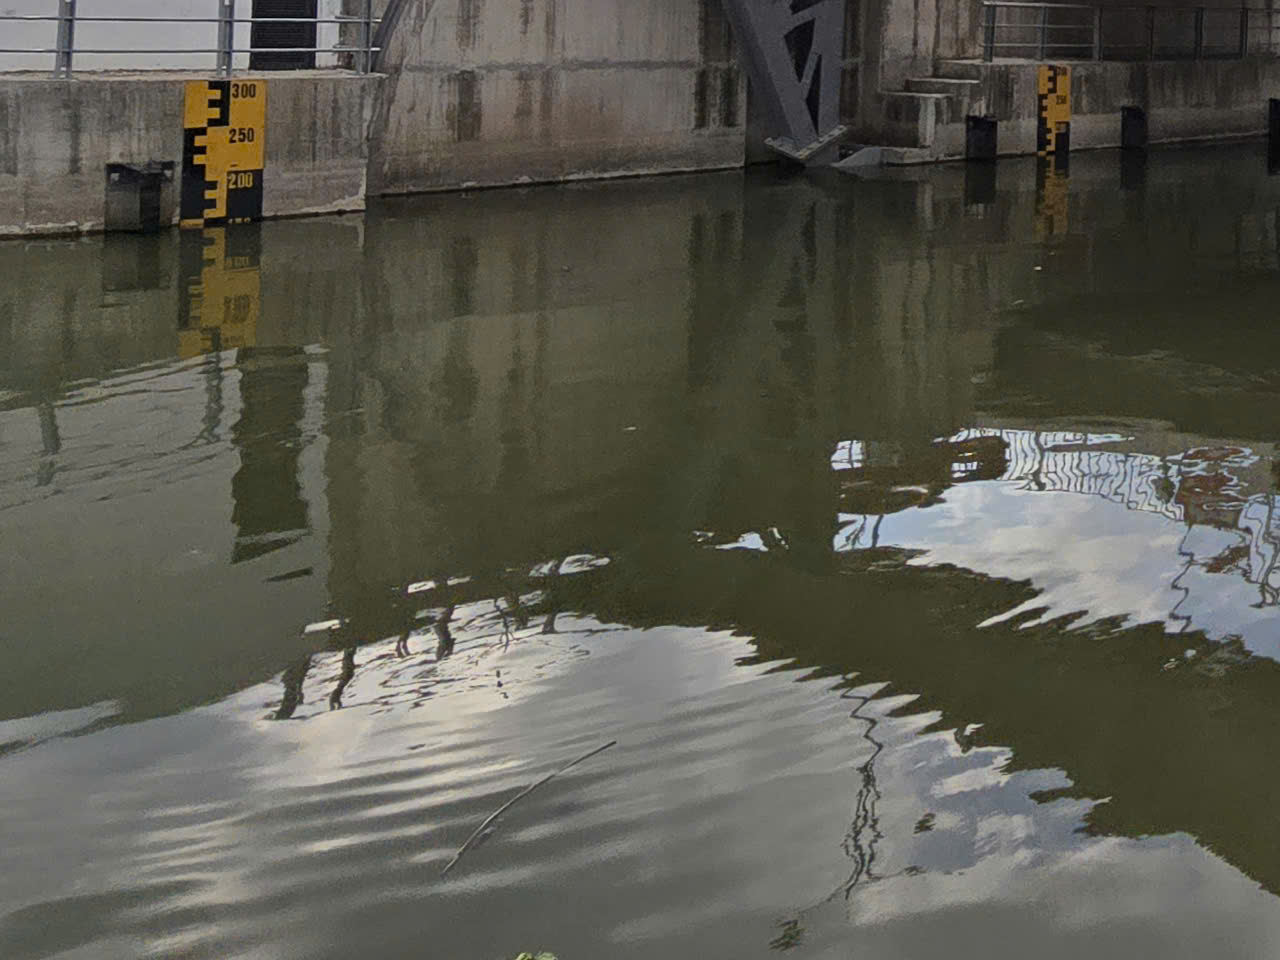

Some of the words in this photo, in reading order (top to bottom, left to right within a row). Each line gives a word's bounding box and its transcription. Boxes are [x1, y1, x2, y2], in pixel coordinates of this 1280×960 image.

[232, 83, 256, 98] 300
[229, 128, 254, 143] 250
[227, 172, 253, 188] 200
